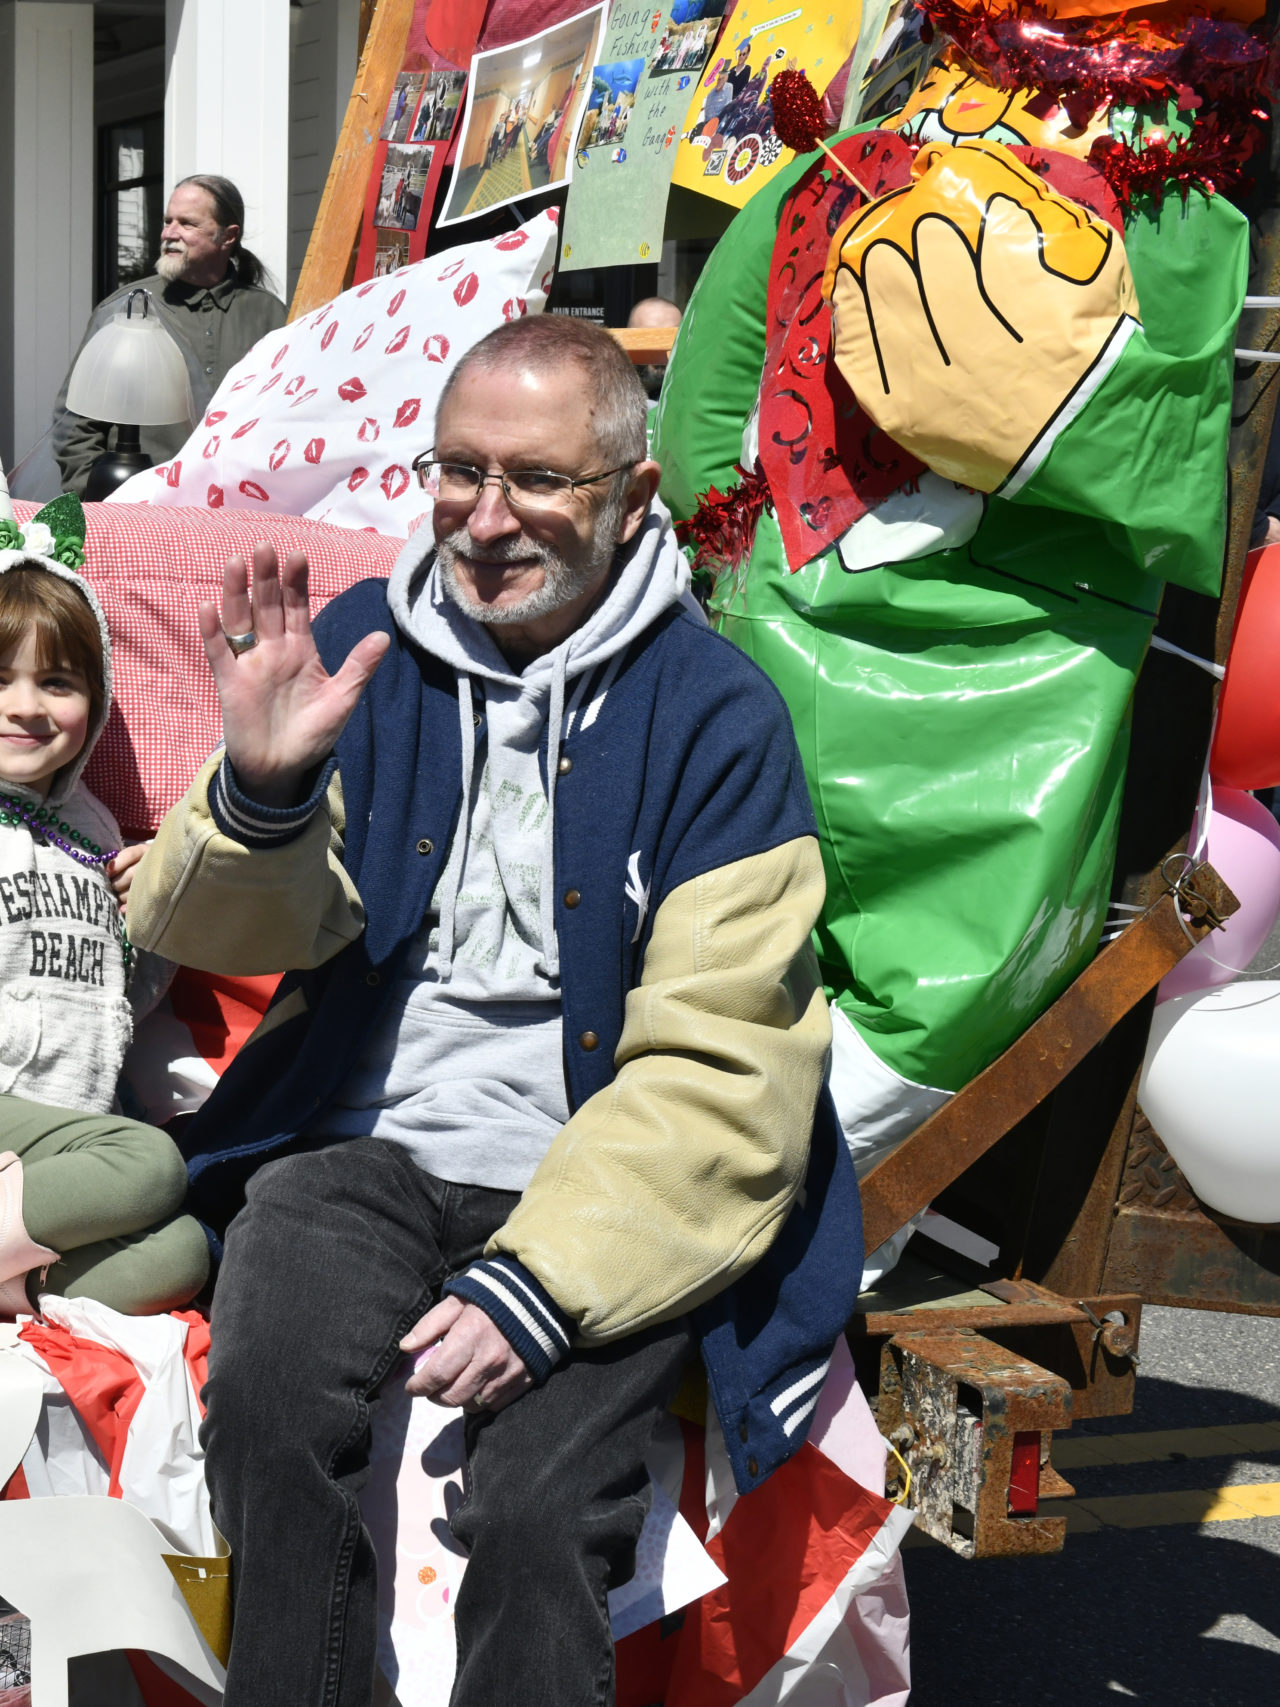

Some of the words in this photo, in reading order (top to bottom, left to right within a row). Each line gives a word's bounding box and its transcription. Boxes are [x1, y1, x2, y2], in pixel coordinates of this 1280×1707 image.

[610, 4, 651, 36] Going
[610, 36, 657, 57] Fishing
[647, 101, 666, 120] the
[642, 126, 667, 154] Gang
[552, 307, 570, 316] MAIN
[571, 307, 605, 316] ENTRANCE
[29, 931, 105, 987] BEACH
